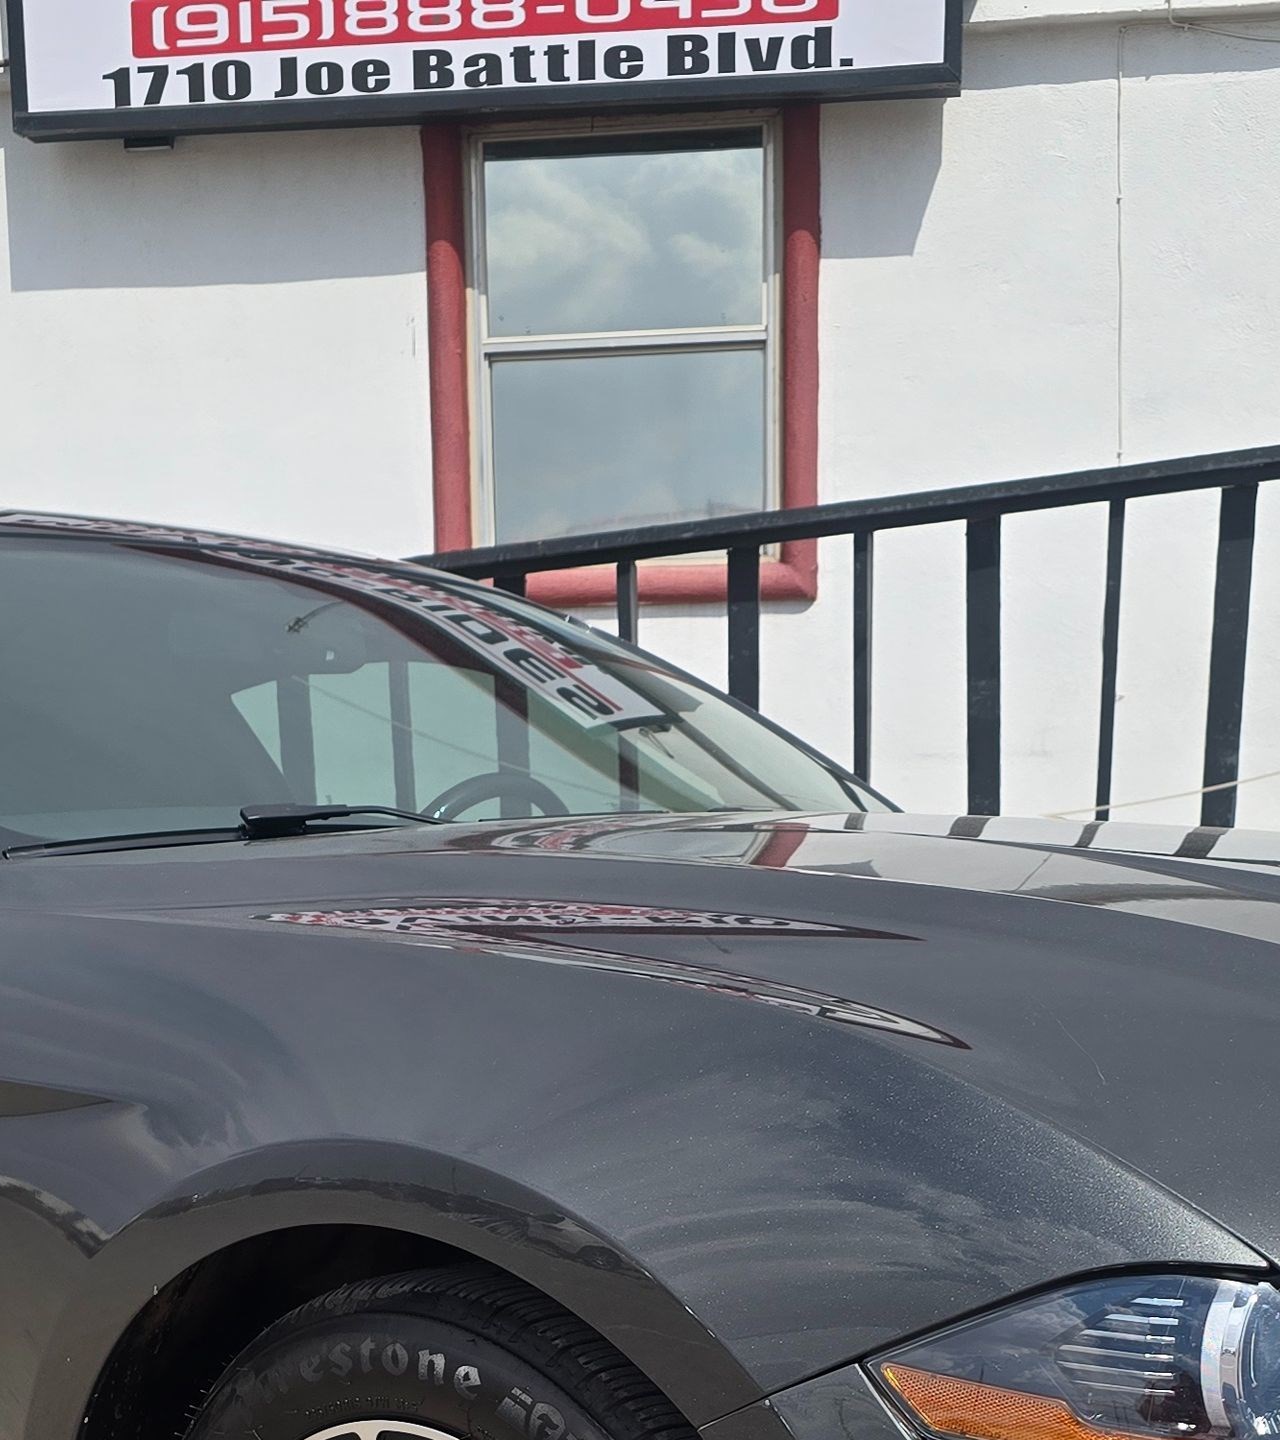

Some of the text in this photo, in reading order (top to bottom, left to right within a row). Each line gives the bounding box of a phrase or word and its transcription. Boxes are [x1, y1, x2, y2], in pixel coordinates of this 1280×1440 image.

[102, 26, 854, 109] 1710 Joe Battle Blvd.
